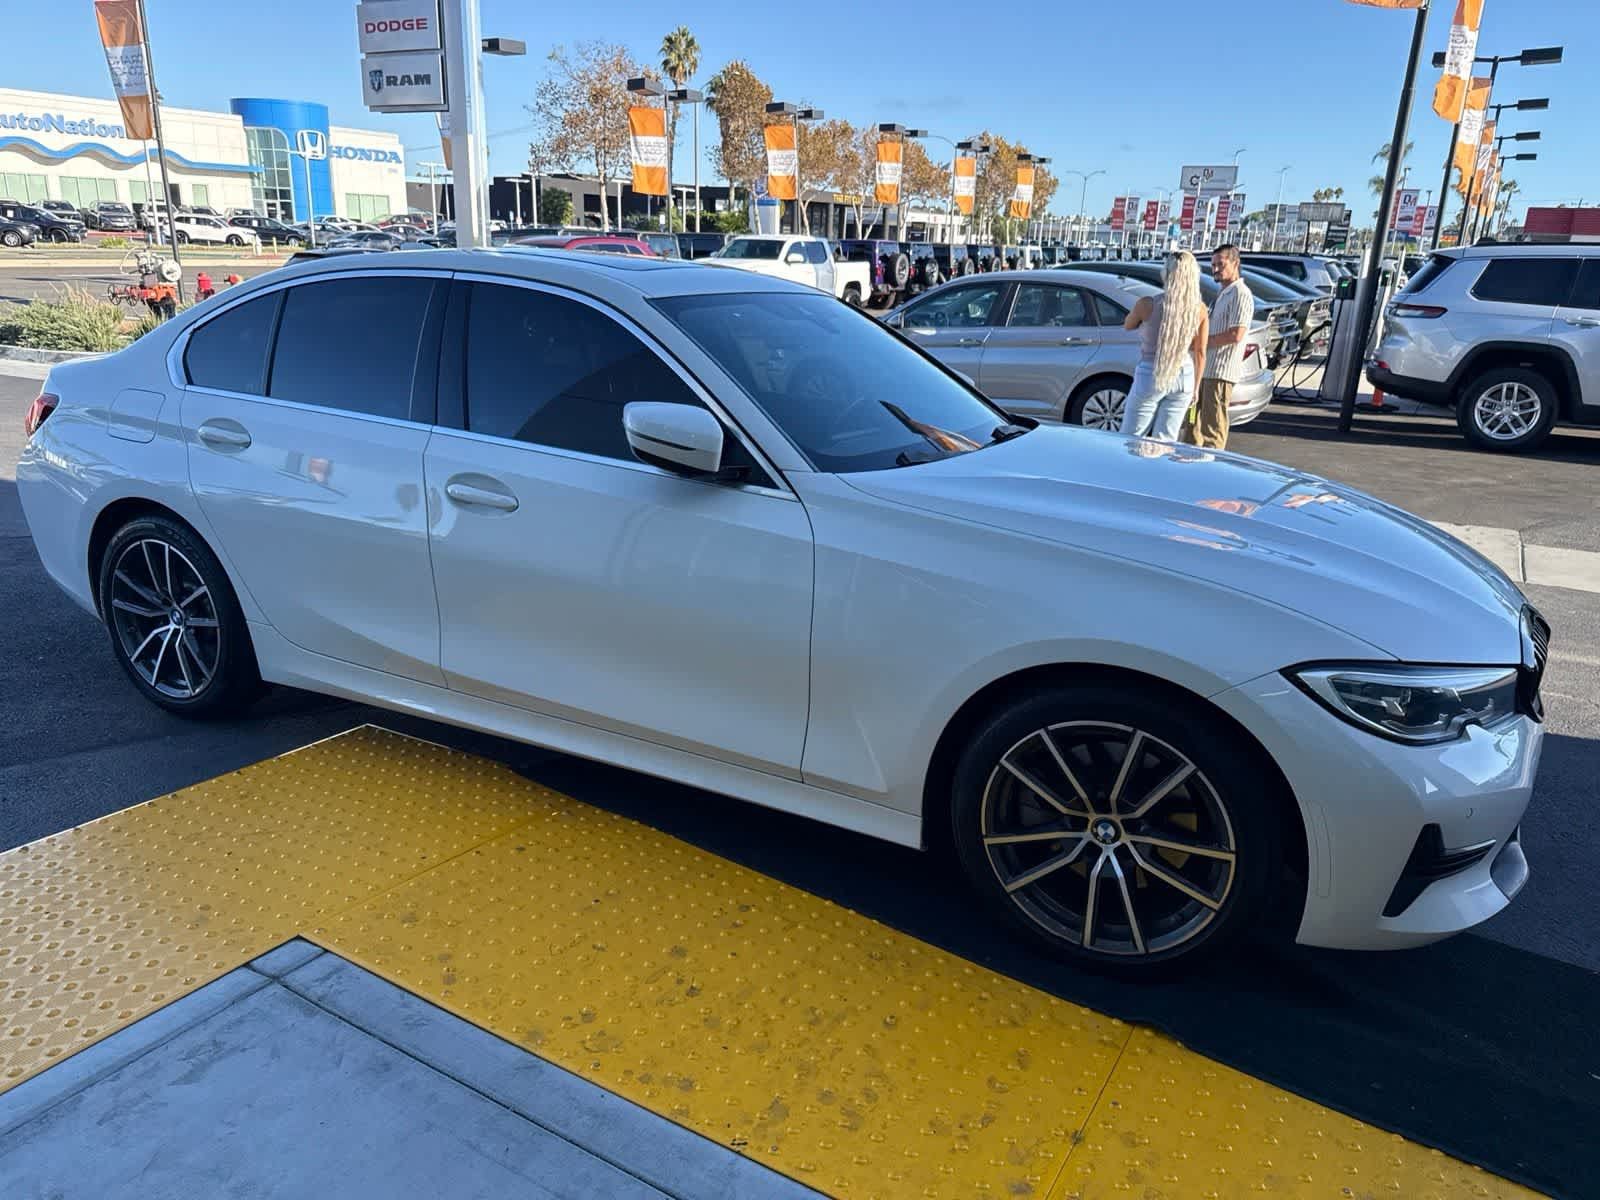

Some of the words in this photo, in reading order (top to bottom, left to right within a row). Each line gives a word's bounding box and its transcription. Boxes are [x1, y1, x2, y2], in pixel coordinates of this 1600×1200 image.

[364, 18, 428, 34] DODGE
[385, 73, 431, 87] RAM
[328, 145, 402, 164] HONDA
